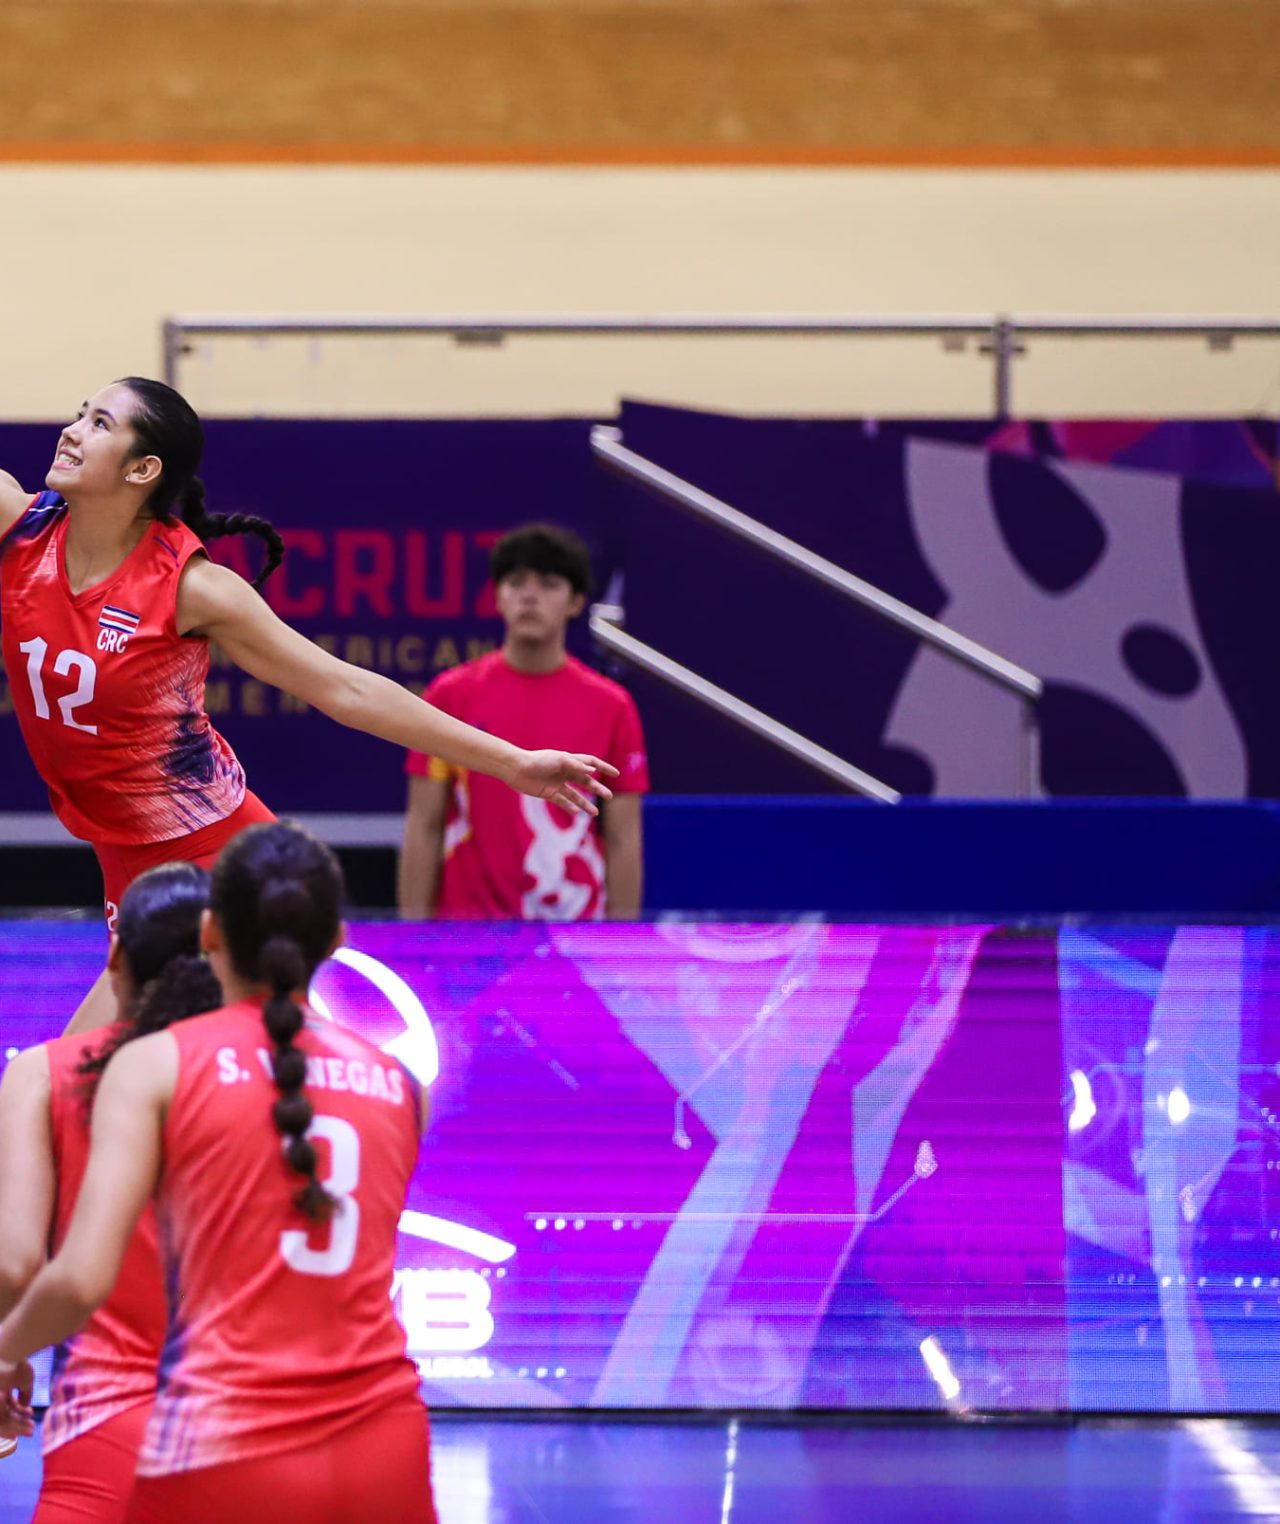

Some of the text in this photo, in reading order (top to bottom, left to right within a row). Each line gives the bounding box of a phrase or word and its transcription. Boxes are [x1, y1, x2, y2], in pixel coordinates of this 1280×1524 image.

[96, 628, 128, 654] CRC
[19, 635, 99, 737] 12
[216, 1046, 405, 1106] S. VNEGAS
[279, 1113, 361, 1278] 3
